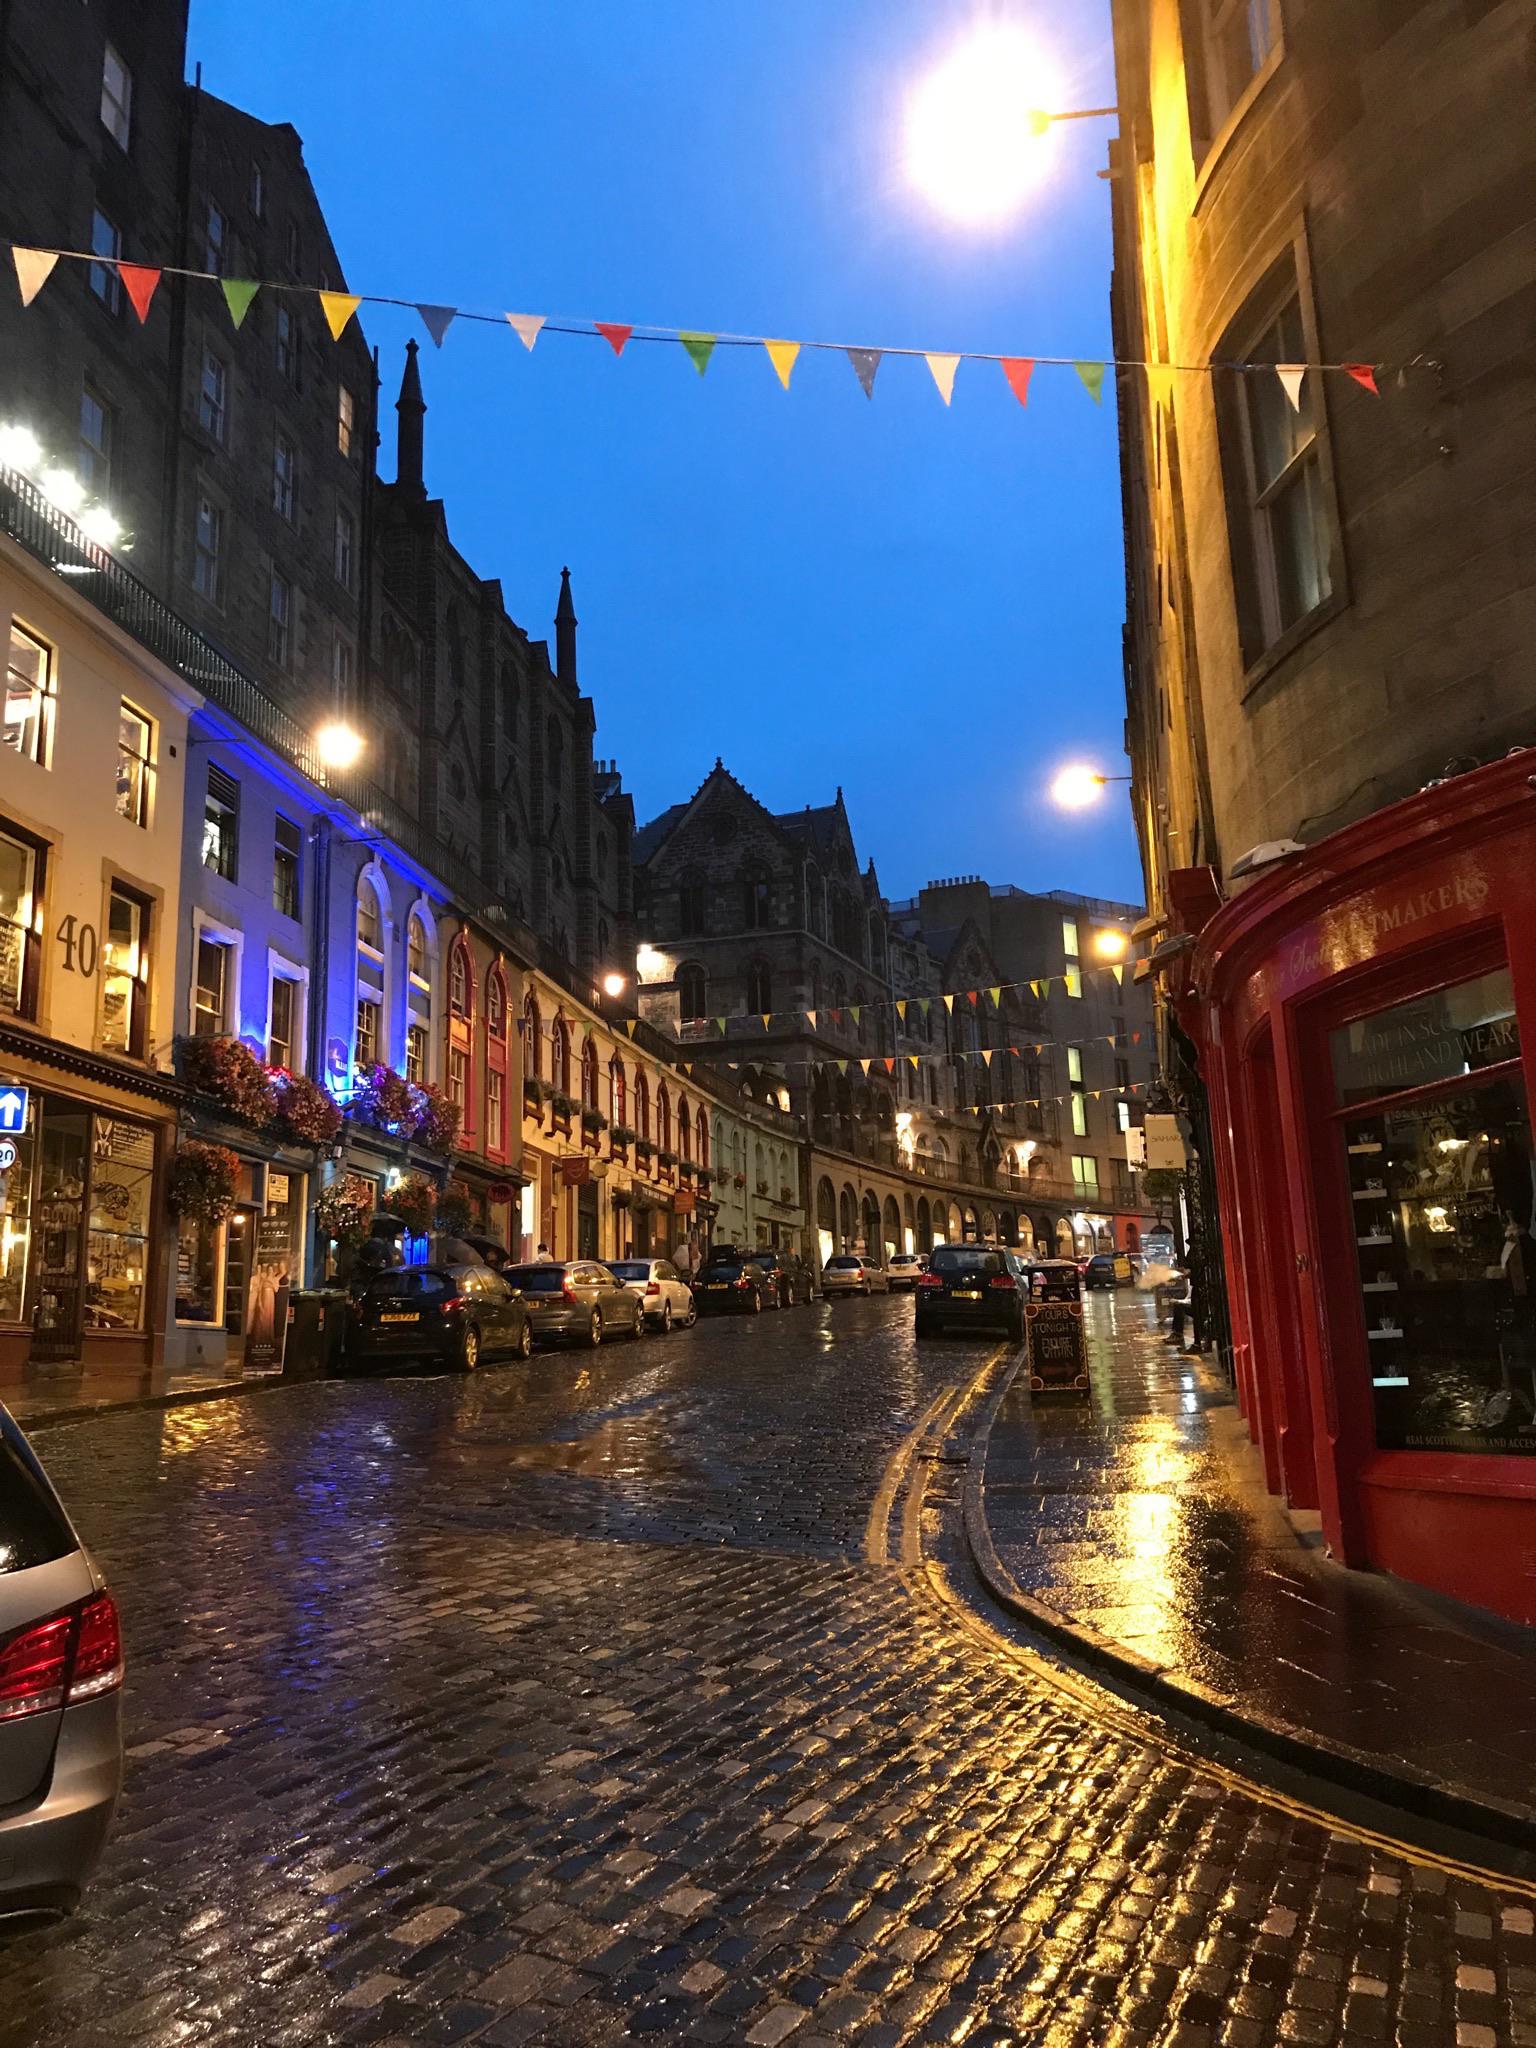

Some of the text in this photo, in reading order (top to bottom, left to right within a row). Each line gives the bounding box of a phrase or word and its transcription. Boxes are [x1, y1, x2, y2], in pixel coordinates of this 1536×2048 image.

[56, 914, 97, 978] 40
[1455, 1020, 1515, 1057] WEAR
[1032, 1322, 1076, 1333] TONIGHT
